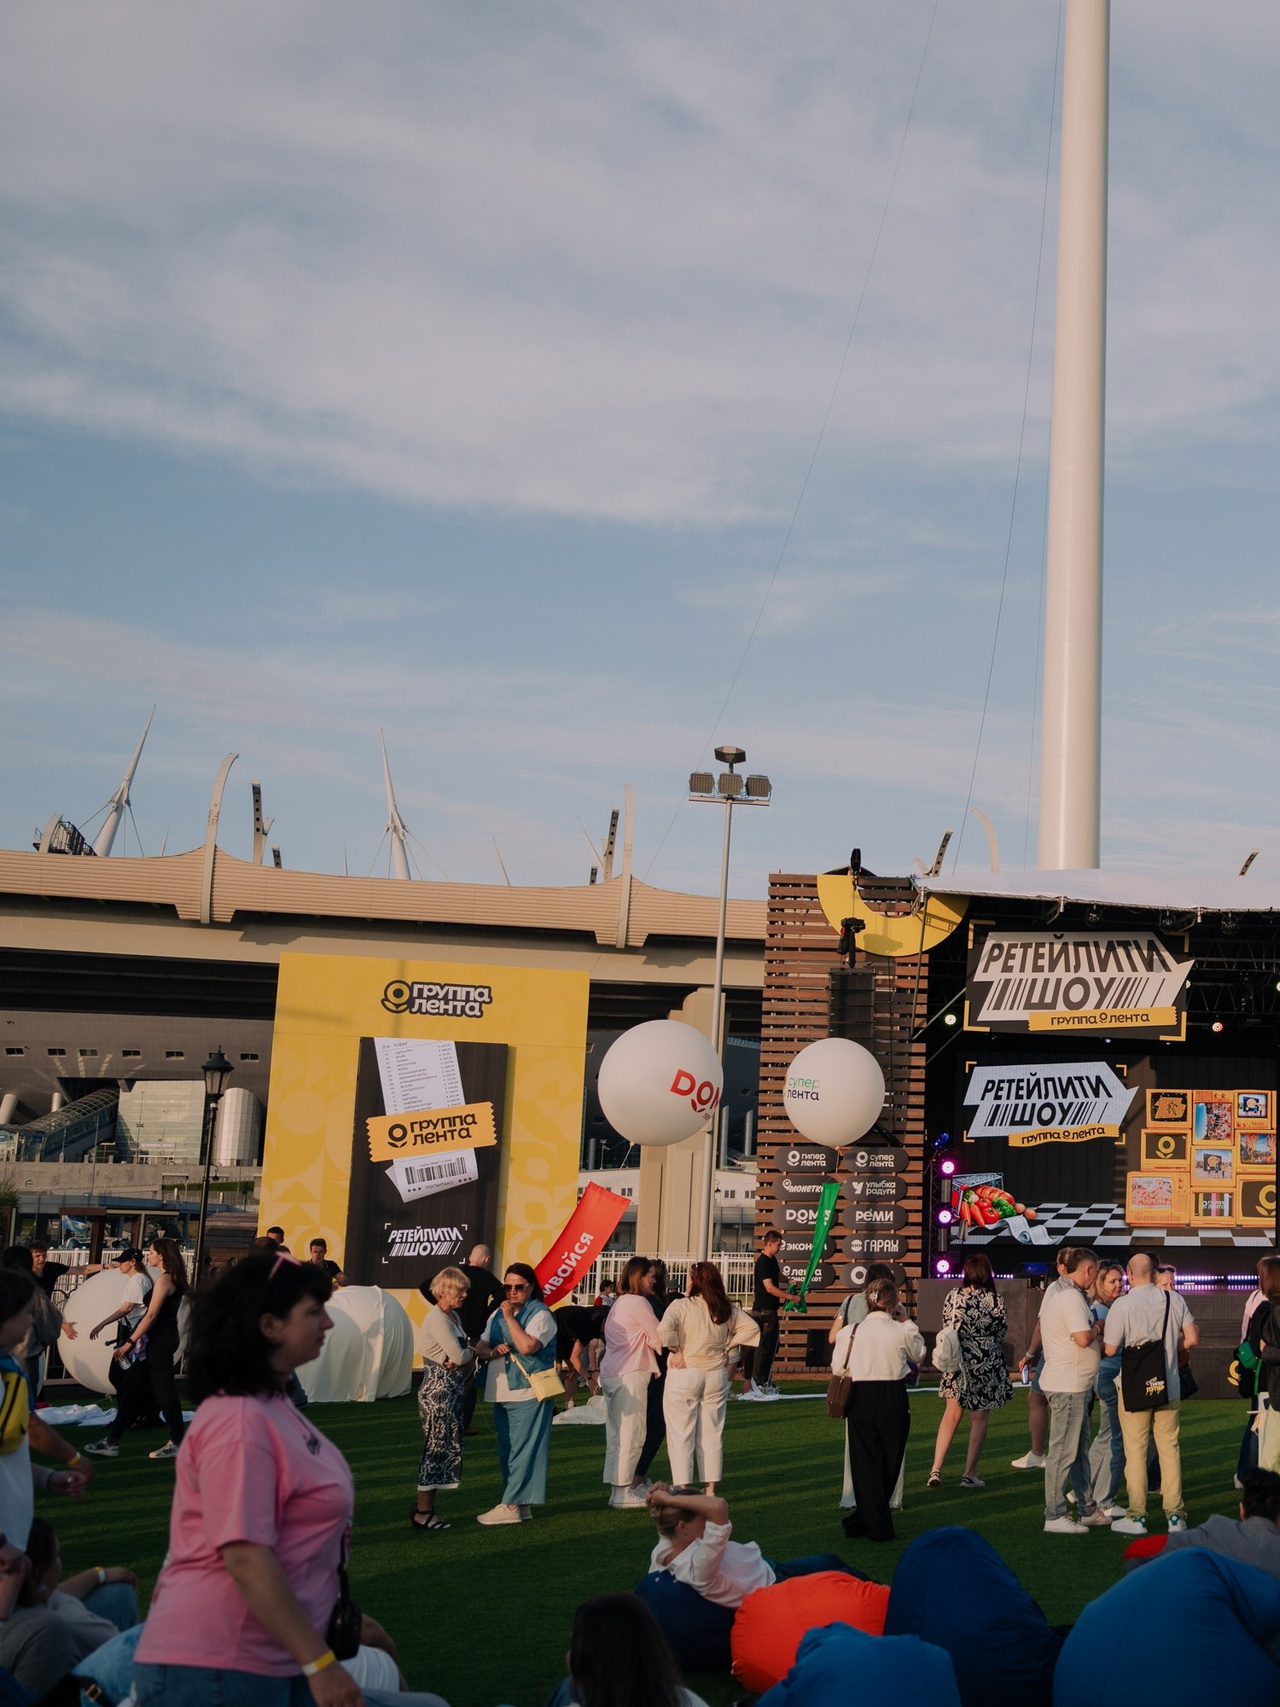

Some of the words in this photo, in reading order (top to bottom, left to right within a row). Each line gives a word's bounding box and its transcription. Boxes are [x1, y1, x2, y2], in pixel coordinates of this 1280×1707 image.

[982, 933, 1173, 974] РЕТЕЙЛИТИ
[412, 983, 490, 1002] группа
[1022, 976, 1117, 1011] ШОУ
[411, 999, 482, 1016] лента
[1051, 1014, 1098, 1026] группа
[1108, 1013, 1150, 1024] лента
[788, 1077, 821, 1090] супер
[980, 1072, 1113, 1101] РЕТЕЙЛИТИ
[787, 1090, 820, 1101] лента
[1009, 1102, 1074, 1127] ШОУ
[410, 1113, 478, 1133] группа
[412, 1127, 472, 1146] лента
[1021, 1131, 1061, 1145] группа
[1071, 1126, 1106, 1140] лента
[801, 1153, 826, 1161] гипер
[868, 1160, 895, 1168] лента
[869, 1154, 895, 1162] супер
[865, 1181, 896, 1189] улыбка
[866, 1188, 896, 1196] радуги
[387, 1225, 464, 1243] РЕТЕЙЛИТИ
[403, 1241, 442, 1256] ШОУ
[864, 1239, 899, 1252] ГАРАЖ
